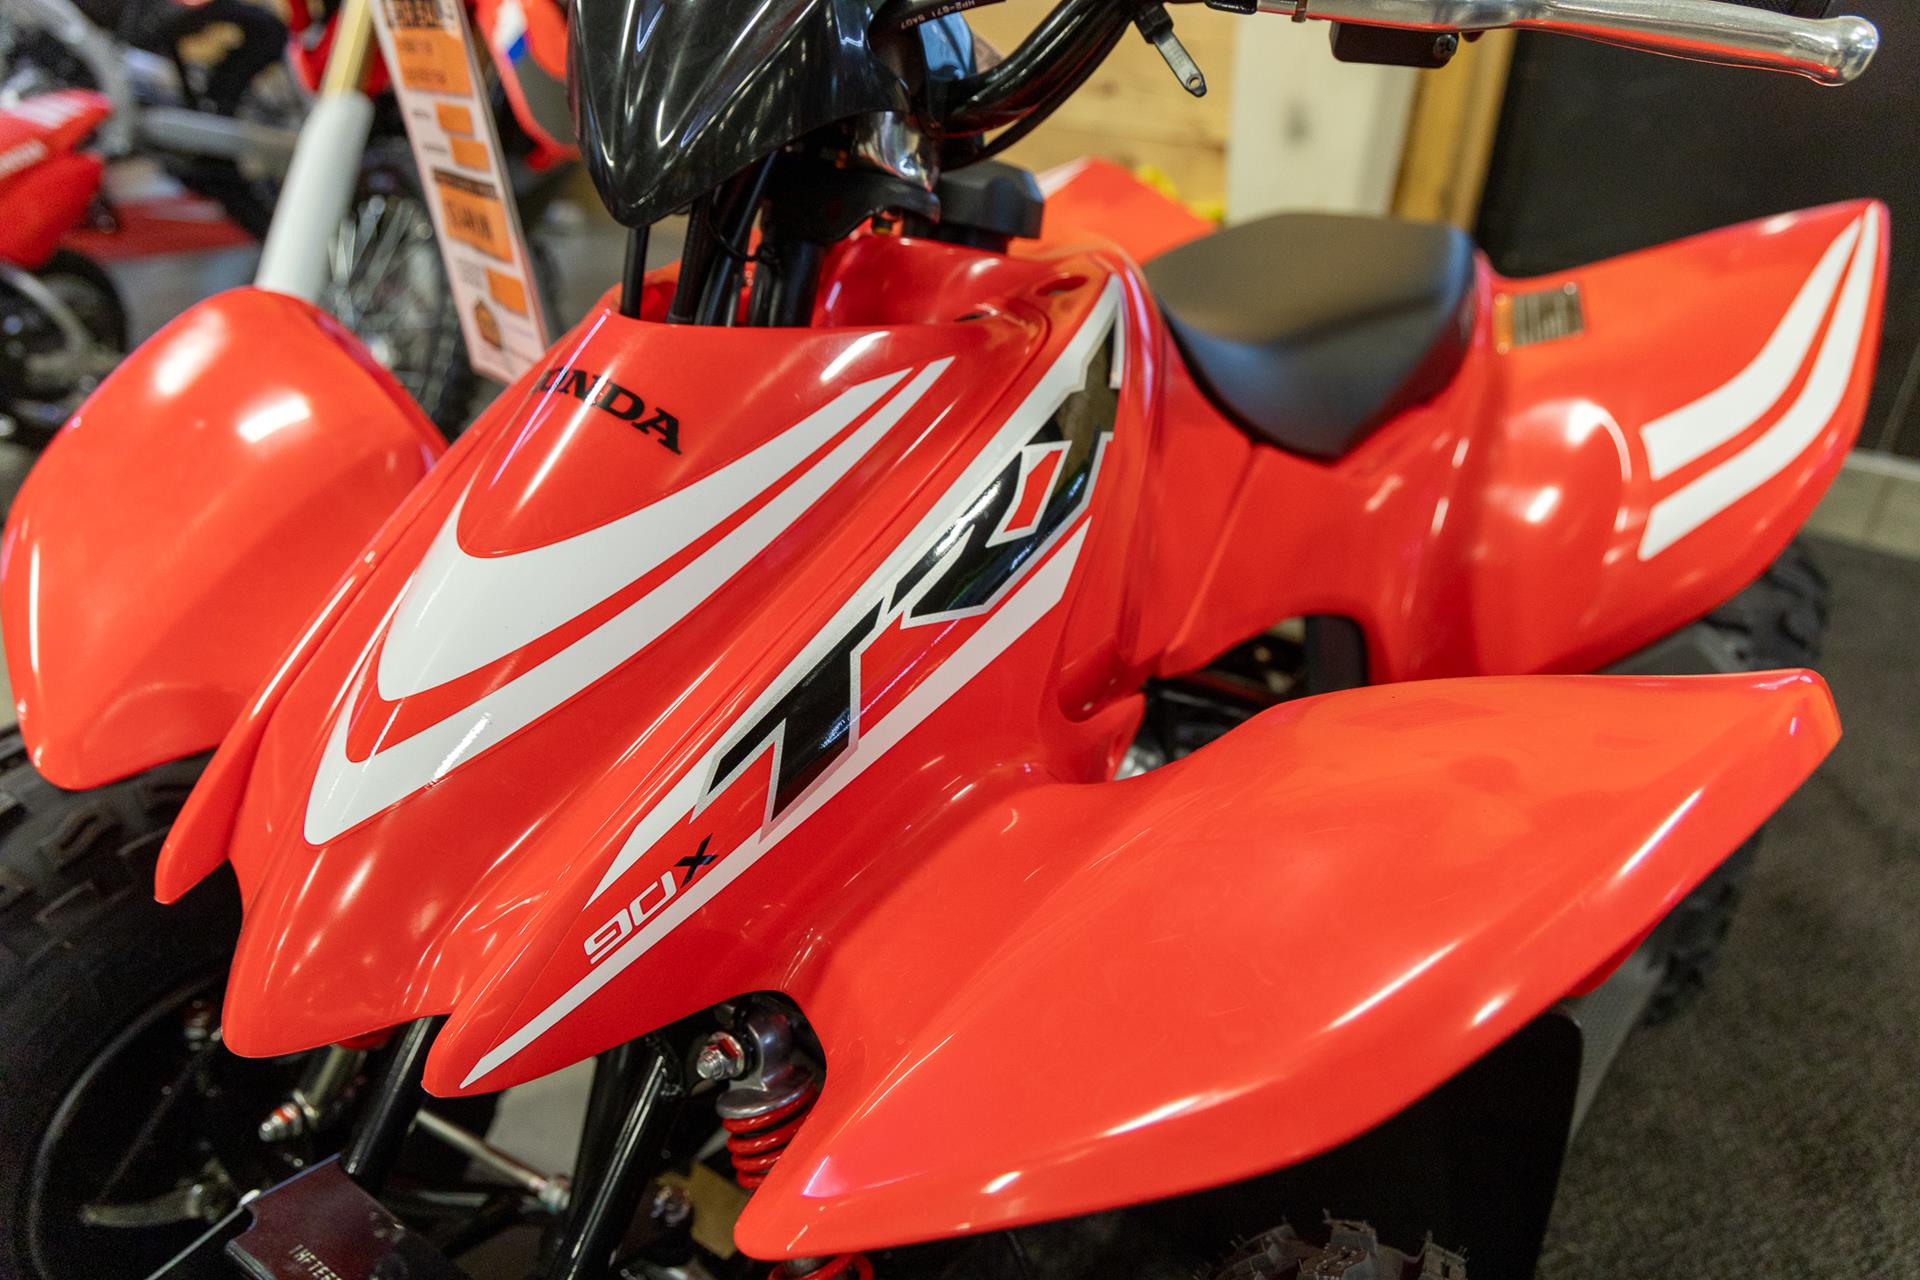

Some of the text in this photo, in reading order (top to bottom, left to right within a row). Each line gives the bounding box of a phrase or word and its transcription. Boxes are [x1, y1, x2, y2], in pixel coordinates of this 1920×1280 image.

[533, 366, 682, 455] ONDA
[692, 312, 1124, 838] TRX
[584, 833, 719, 964] 90X
